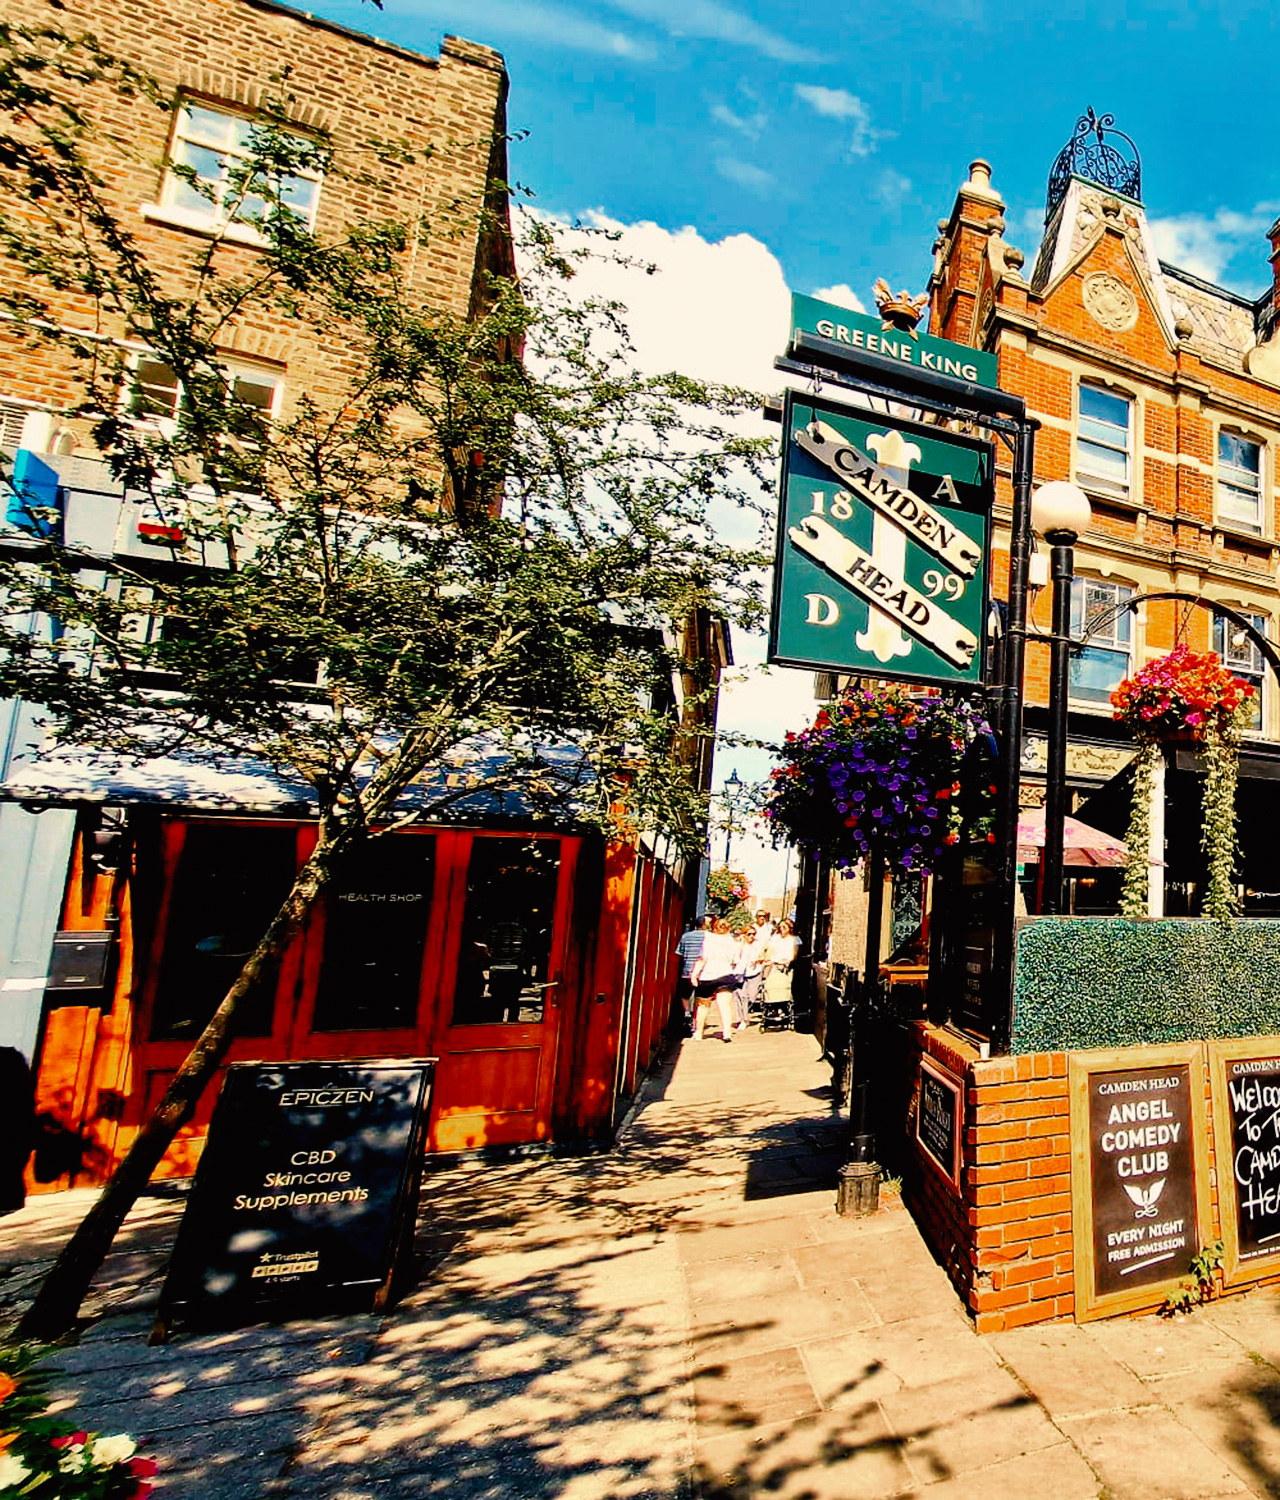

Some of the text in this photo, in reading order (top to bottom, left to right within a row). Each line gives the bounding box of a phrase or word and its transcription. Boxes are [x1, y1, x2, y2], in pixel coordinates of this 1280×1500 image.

[815, 319, 979, 382] GREENE KING
[833, 447, 956, 550] CAMDEN
[931, 474, 962, 505] A
[810, 490, 854, 521] 18
[845, 556, 931, 626] HEAD
[921, 568, 966, 602] 99
[804, 592, 840, 626] D
[338, 893, 424, 902] HEALTH SHOP
[1232, 1060, 1274, 1075] CAMDEN
[279, 1089, 375, 1107] EPICZEN
[1098, 1076, 1180, 1096] CAMDEN HEAD
[1107, 1099, 1174, 1125] ANGEL
[1100, 1122, 1181, 1153] COMEDY
[290, 1150, 337, 1166] CBD
[1117, 1151, 1169, 1178] CLUB
[263, 1170, 352, 1189] Skincare
[233, 1186, 369, 1211] Supplements
[1106, 1218, 1185, 1247] EVERY NIGHT
[1107, 1236, 1186, 1263] FREE ADMISSION
